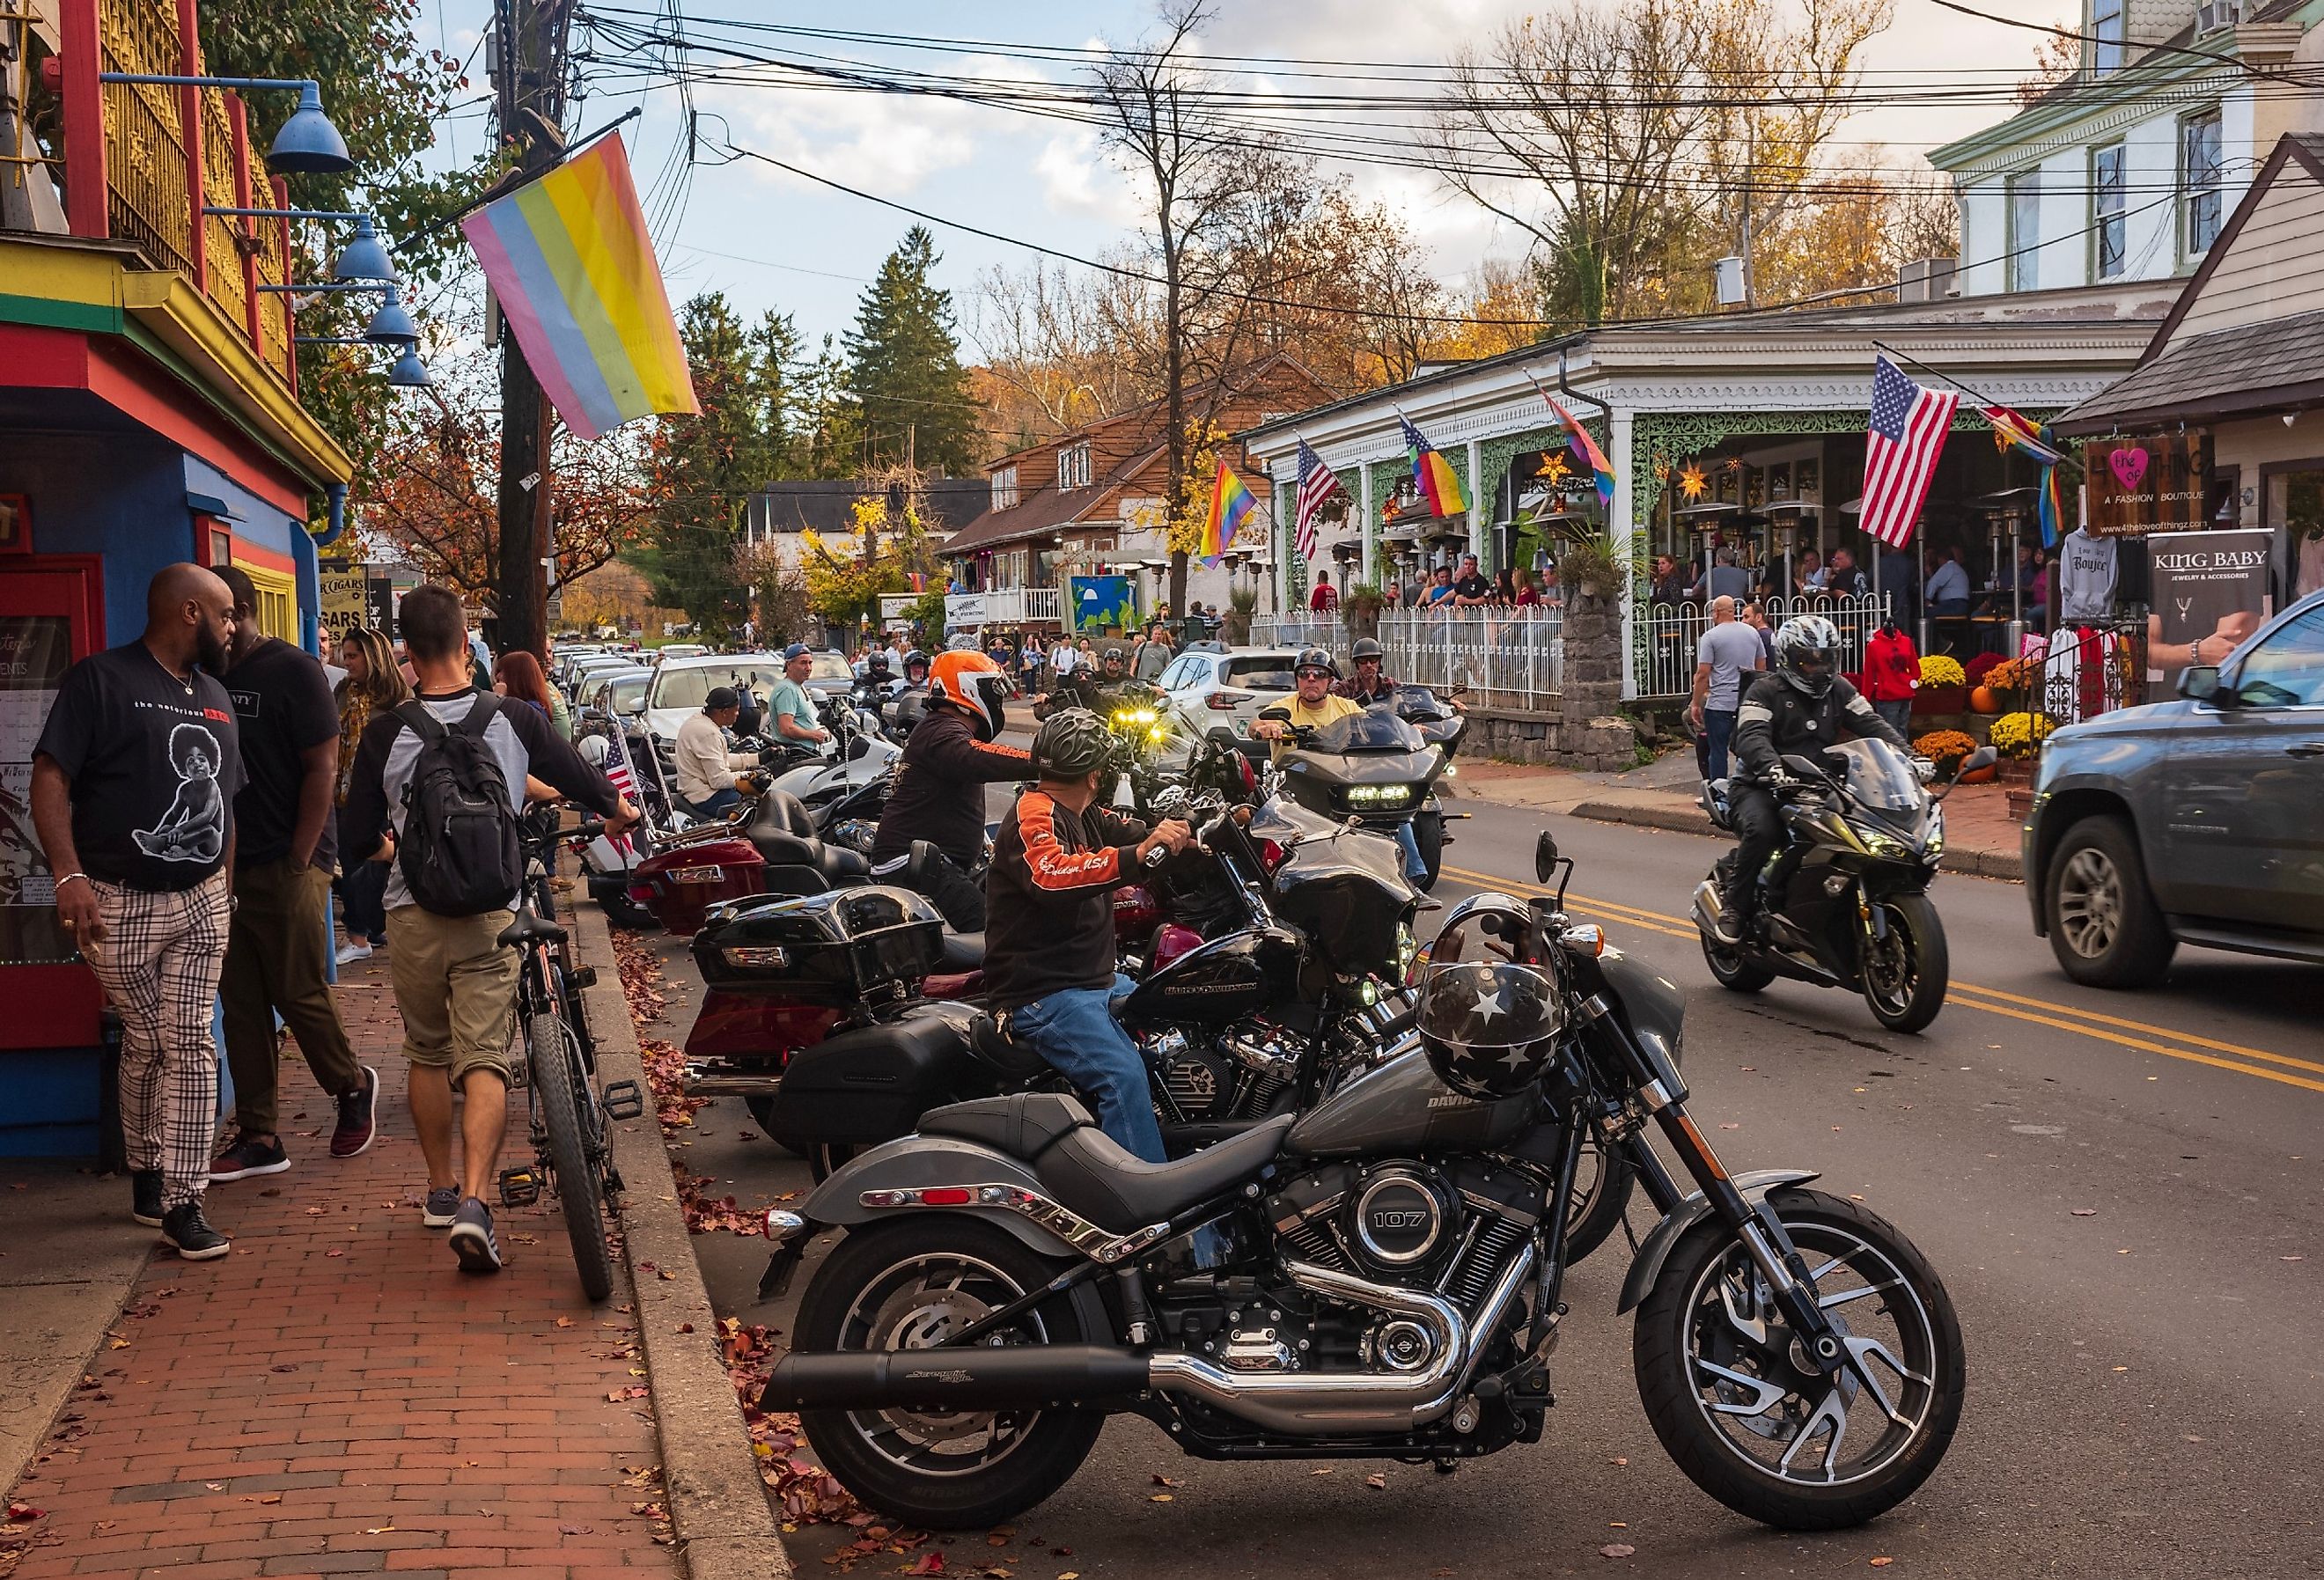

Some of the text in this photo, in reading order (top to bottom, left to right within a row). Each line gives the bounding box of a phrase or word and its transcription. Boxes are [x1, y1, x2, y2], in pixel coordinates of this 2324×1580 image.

[2115, 454, 2135, 468] the
[2126, 468, 2141, 481] of
[2105, 490, 2205, 504] A FASHION BOUTIQUE
[2100, 520, 2208, 533] www.4theloveofthingz.com
[2072, 556, 2107, 573] Boujee
[2154, 550, 2268, 569] KING BABY
[158, 703, 204, 717] notorious
[1084, 856, 1109, 871] USA
[1374, 1211, 1426, 1228] 107
